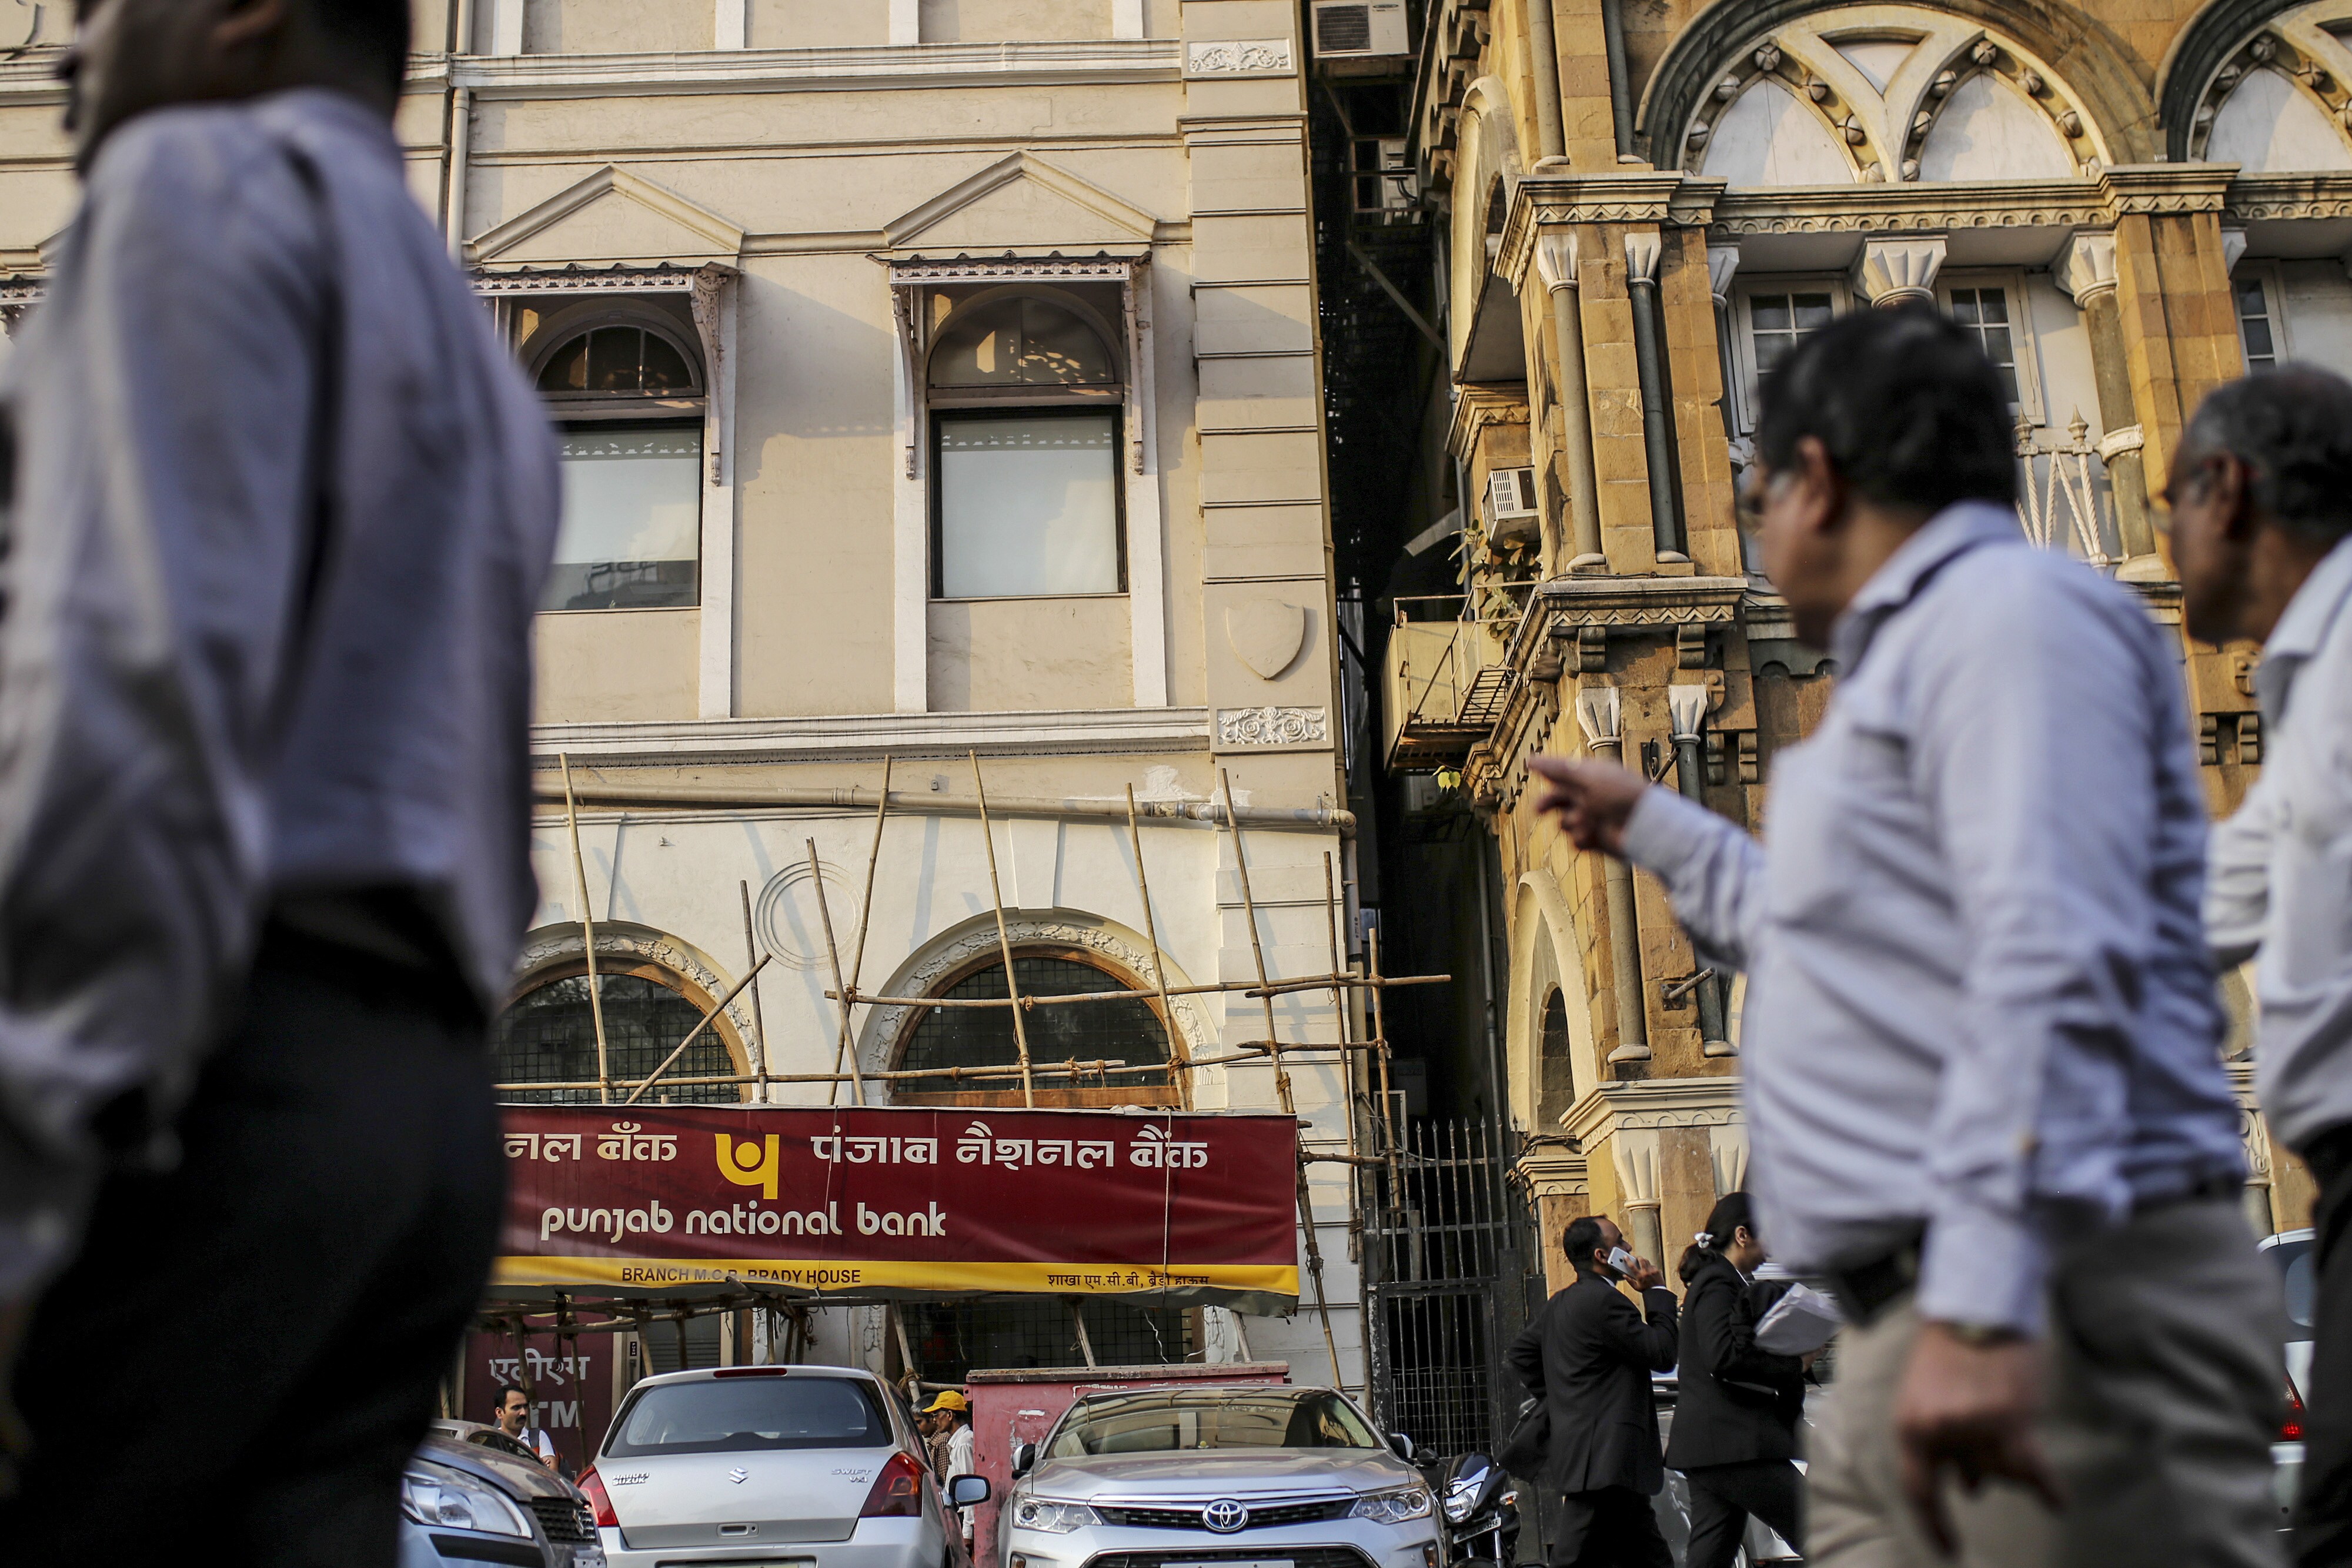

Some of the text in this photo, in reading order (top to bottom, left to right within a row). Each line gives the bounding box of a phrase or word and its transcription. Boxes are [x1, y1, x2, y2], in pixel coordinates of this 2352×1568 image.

[504, 1134, 581, 1162] नल
[810, 1121, 1208, 1170] पंजाब नैशनल बैंक
[541, 1201, 946, 1243] punjab national bank
[622, 1268, 689, 1281] BRANCH
[748, 1269, 802, 1283] BRADY
[807, 1269, 860, 1284] HOUSE
[1047, 1275, 1081, 1286] शाखा
[493, 1400, 584, 1428] TM
[612, 1472, 650, 1480] MARUTI
